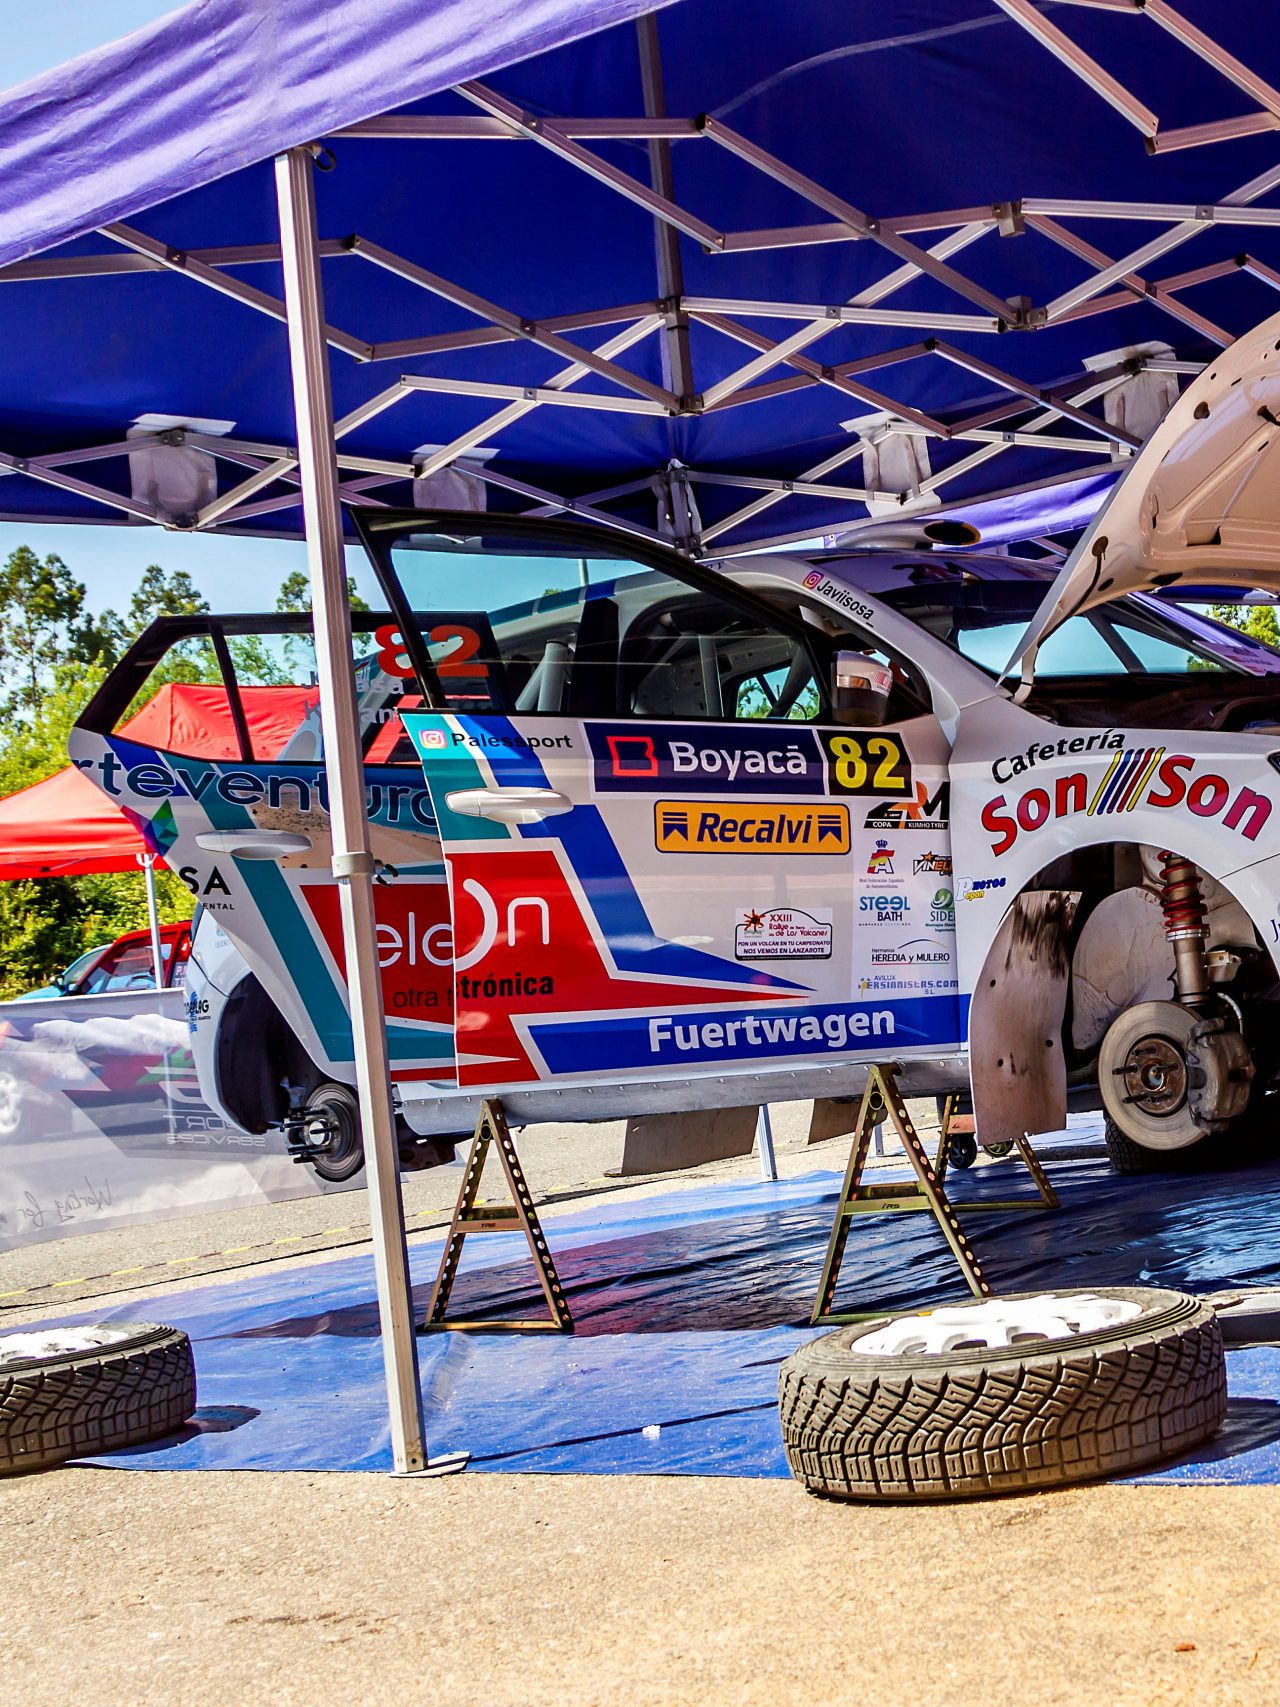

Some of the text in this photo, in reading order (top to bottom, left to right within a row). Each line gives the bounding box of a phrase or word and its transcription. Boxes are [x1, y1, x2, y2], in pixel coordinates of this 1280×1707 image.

[375, 624, 489, 678] 82
[451, 733, 574, 749] Palessport
[991, 728, 1126, 784] Cafetería
[669, 741, 807, 781] Boyacá
[829, 736, 905, 789] 82
[981, 754, 1273, 857] Son Son
[697, 812, 812, 844] Recalvi
[769, 914, 792, 922] XXIII
[877, 911, 903, 922] BATH
[871, 953, 906, 962] HEREDIA
[916, 953, 950, 962] MULERO
[392, 987, 438, 1008] otra
[649, 1010, 896, 1052] Fuertwagen
